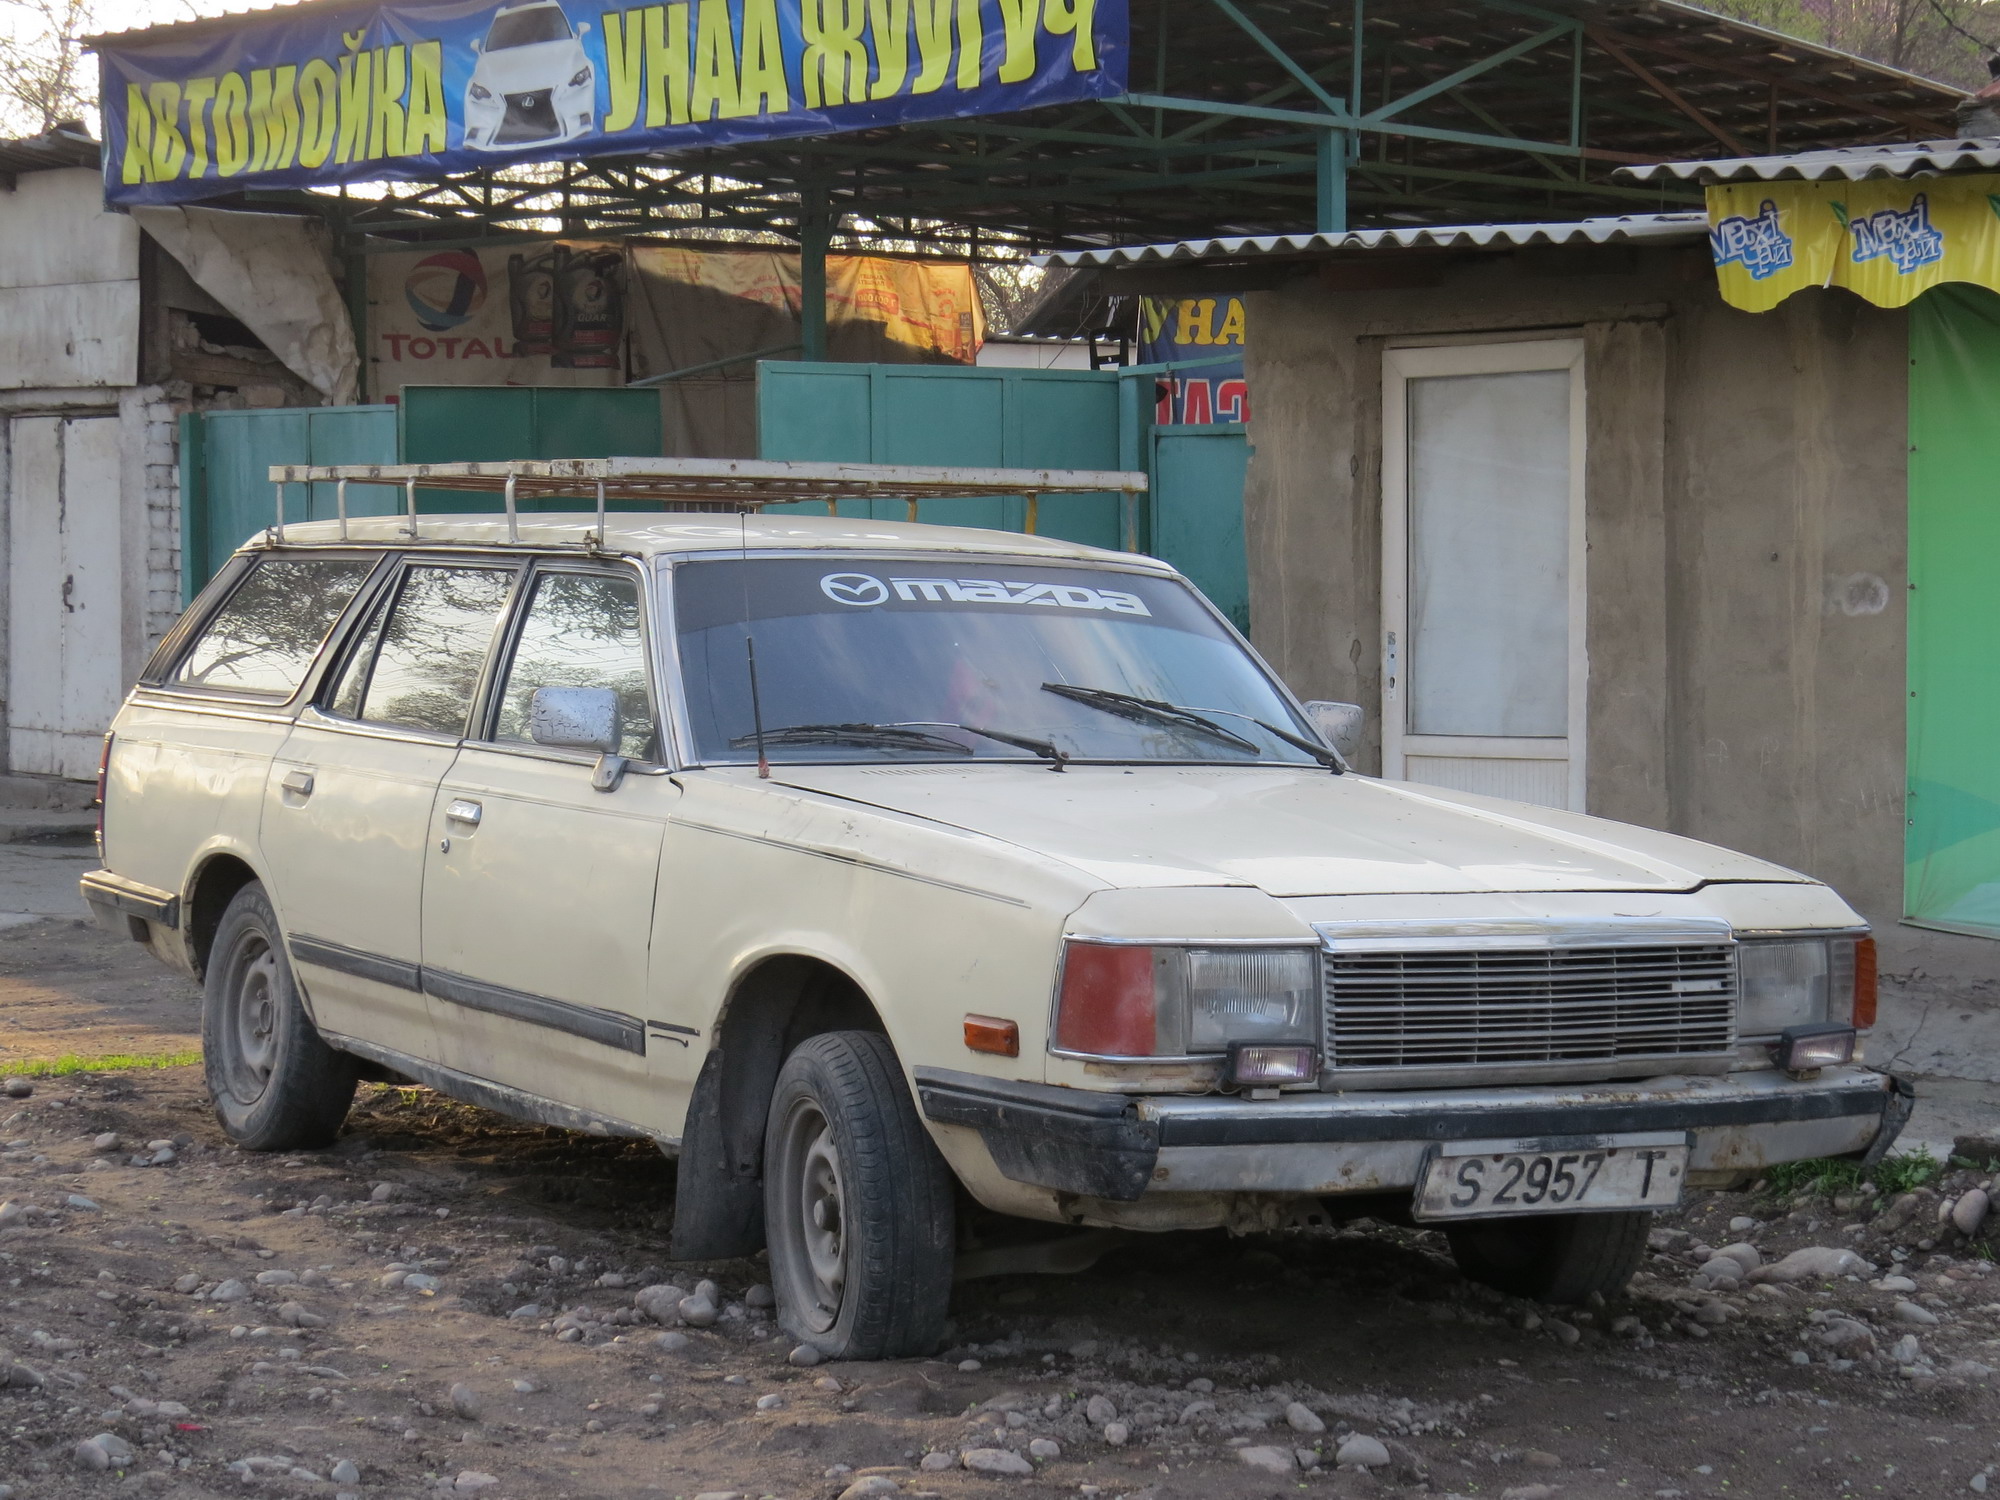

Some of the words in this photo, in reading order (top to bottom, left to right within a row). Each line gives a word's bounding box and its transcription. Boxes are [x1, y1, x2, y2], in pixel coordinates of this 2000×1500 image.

[122, 30, 447, 186] АВТОМОЙКА
[603, 0, 788, 133] УНАА
[382, 334, 515, 362] TOTAL
[1450, 1159, 1484, 1208] S
[1491, 1153, 1606, 1205] 2957
[1635, 1150, 1667, 1199] T
